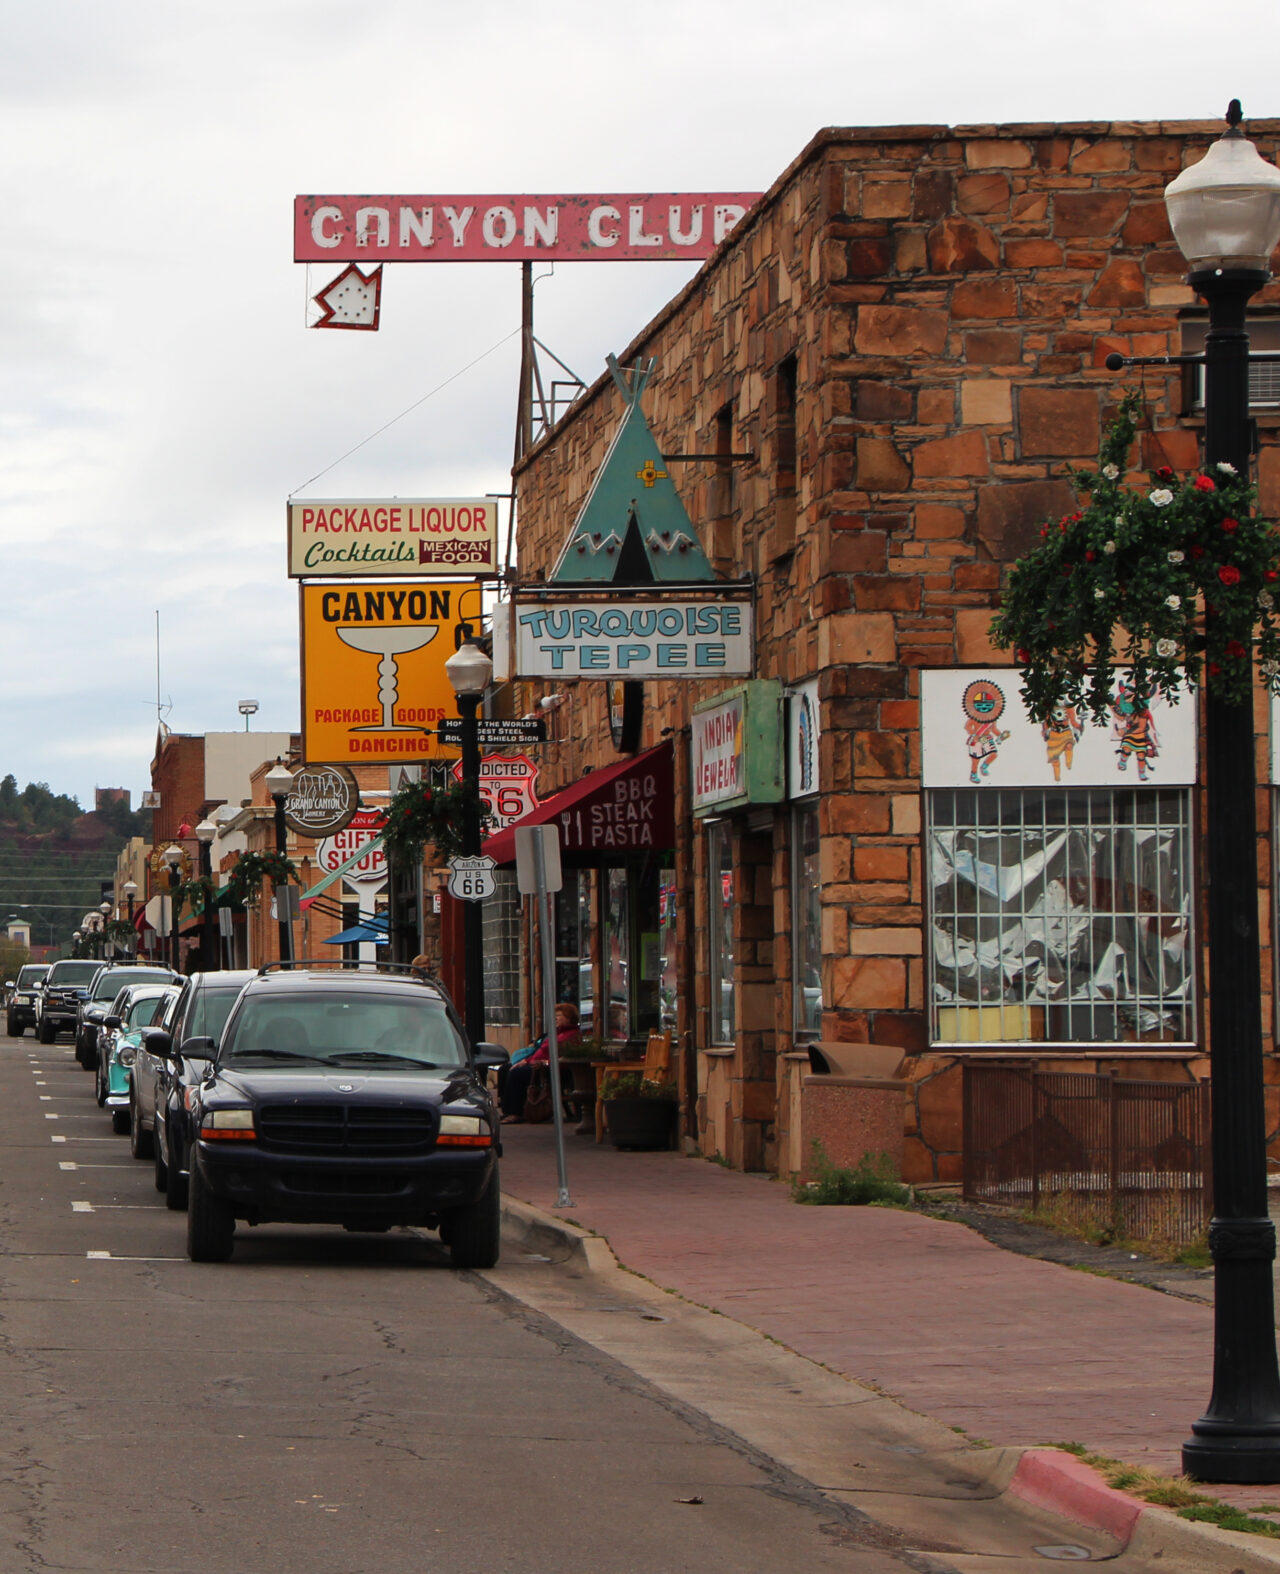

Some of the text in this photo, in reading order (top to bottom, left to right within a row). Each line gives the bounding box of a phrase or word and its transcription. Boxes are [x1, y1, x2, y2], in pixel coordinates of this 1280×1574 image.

[311, 205, 559, 249] CANYON
[302, 507, 487, 534] PACKAGE LIQUOR
[304, 541, 415, 568] Cocktails
[423, 541, 489, 552] MEXICAN
[431, 552, 483, 563] FOOD
[322, 590, 451, 622] CANYON
[519, 606, 741, 639] TURQUOISE
[540, 643, 726, 669] TEPEE
[315, 708, 446, 723] PACKAGE GOODS
[349, 738, 429, 752] DANCING
[487, 734, 517, 742] SHIELD
[481, 763, 527, 776] DICTED
[490, 781, 501, 790] TO
[615, 775, 656, 803] BBQ
[291, 797, 340, 810] GRAND CANYON
[591, 800, 654, 823] STEAK
[334, 831, 378, 850] GIFT
[592, 823, 653, 847] PASTA
[327, 851, 385, 871] SHOP
[463, 879, 484, 895] 66
